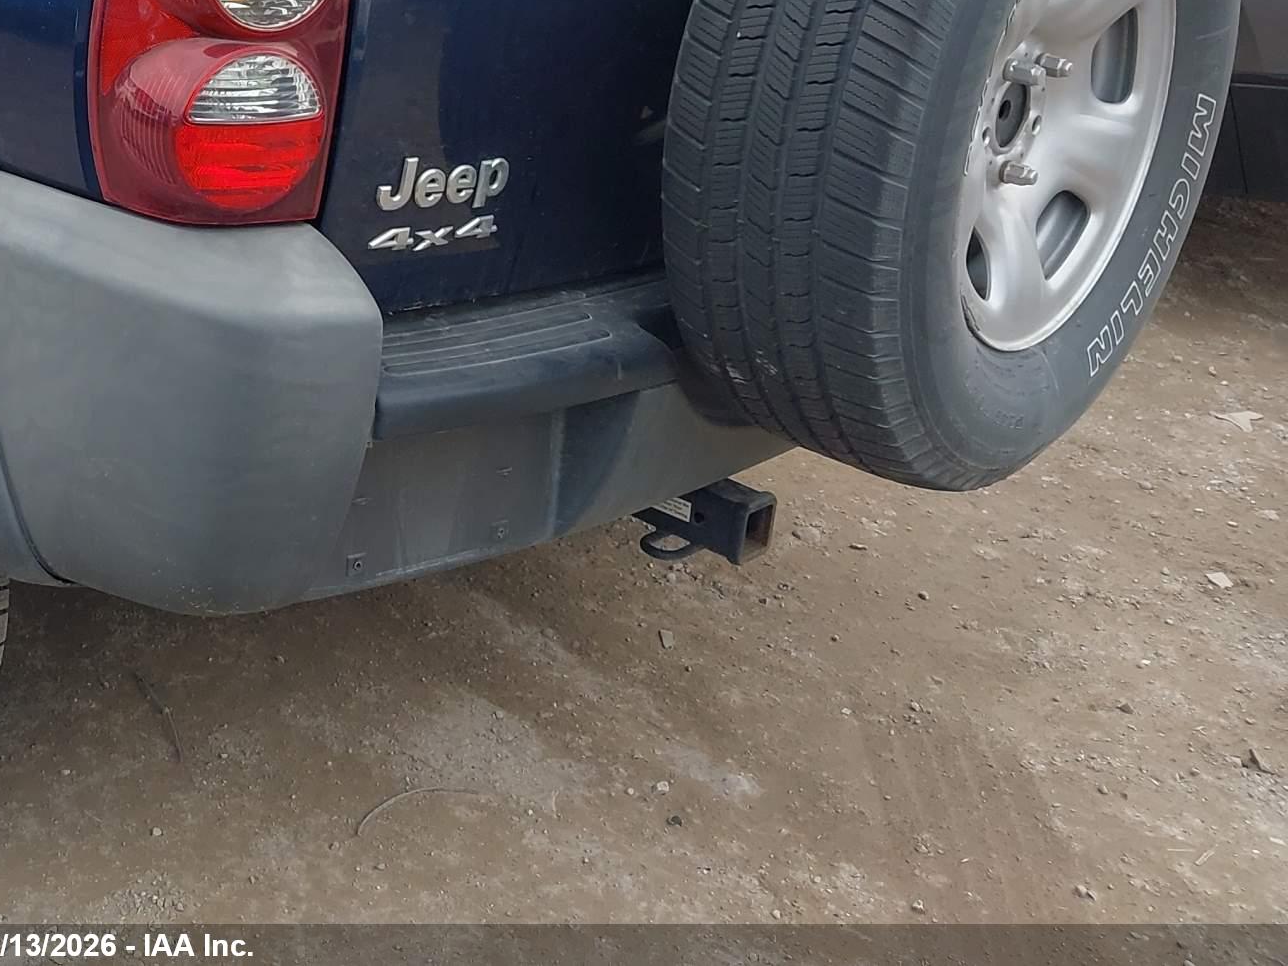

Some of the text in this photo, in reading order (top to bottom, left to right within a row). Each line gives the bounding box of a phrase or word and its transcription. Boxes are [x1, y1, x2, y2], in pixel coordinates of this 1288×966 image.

[376, 156, 510, 211] Jeep
[367, 214, 499, 252] 4x4
[1086, 93, 1217, 378] MICHELIN
